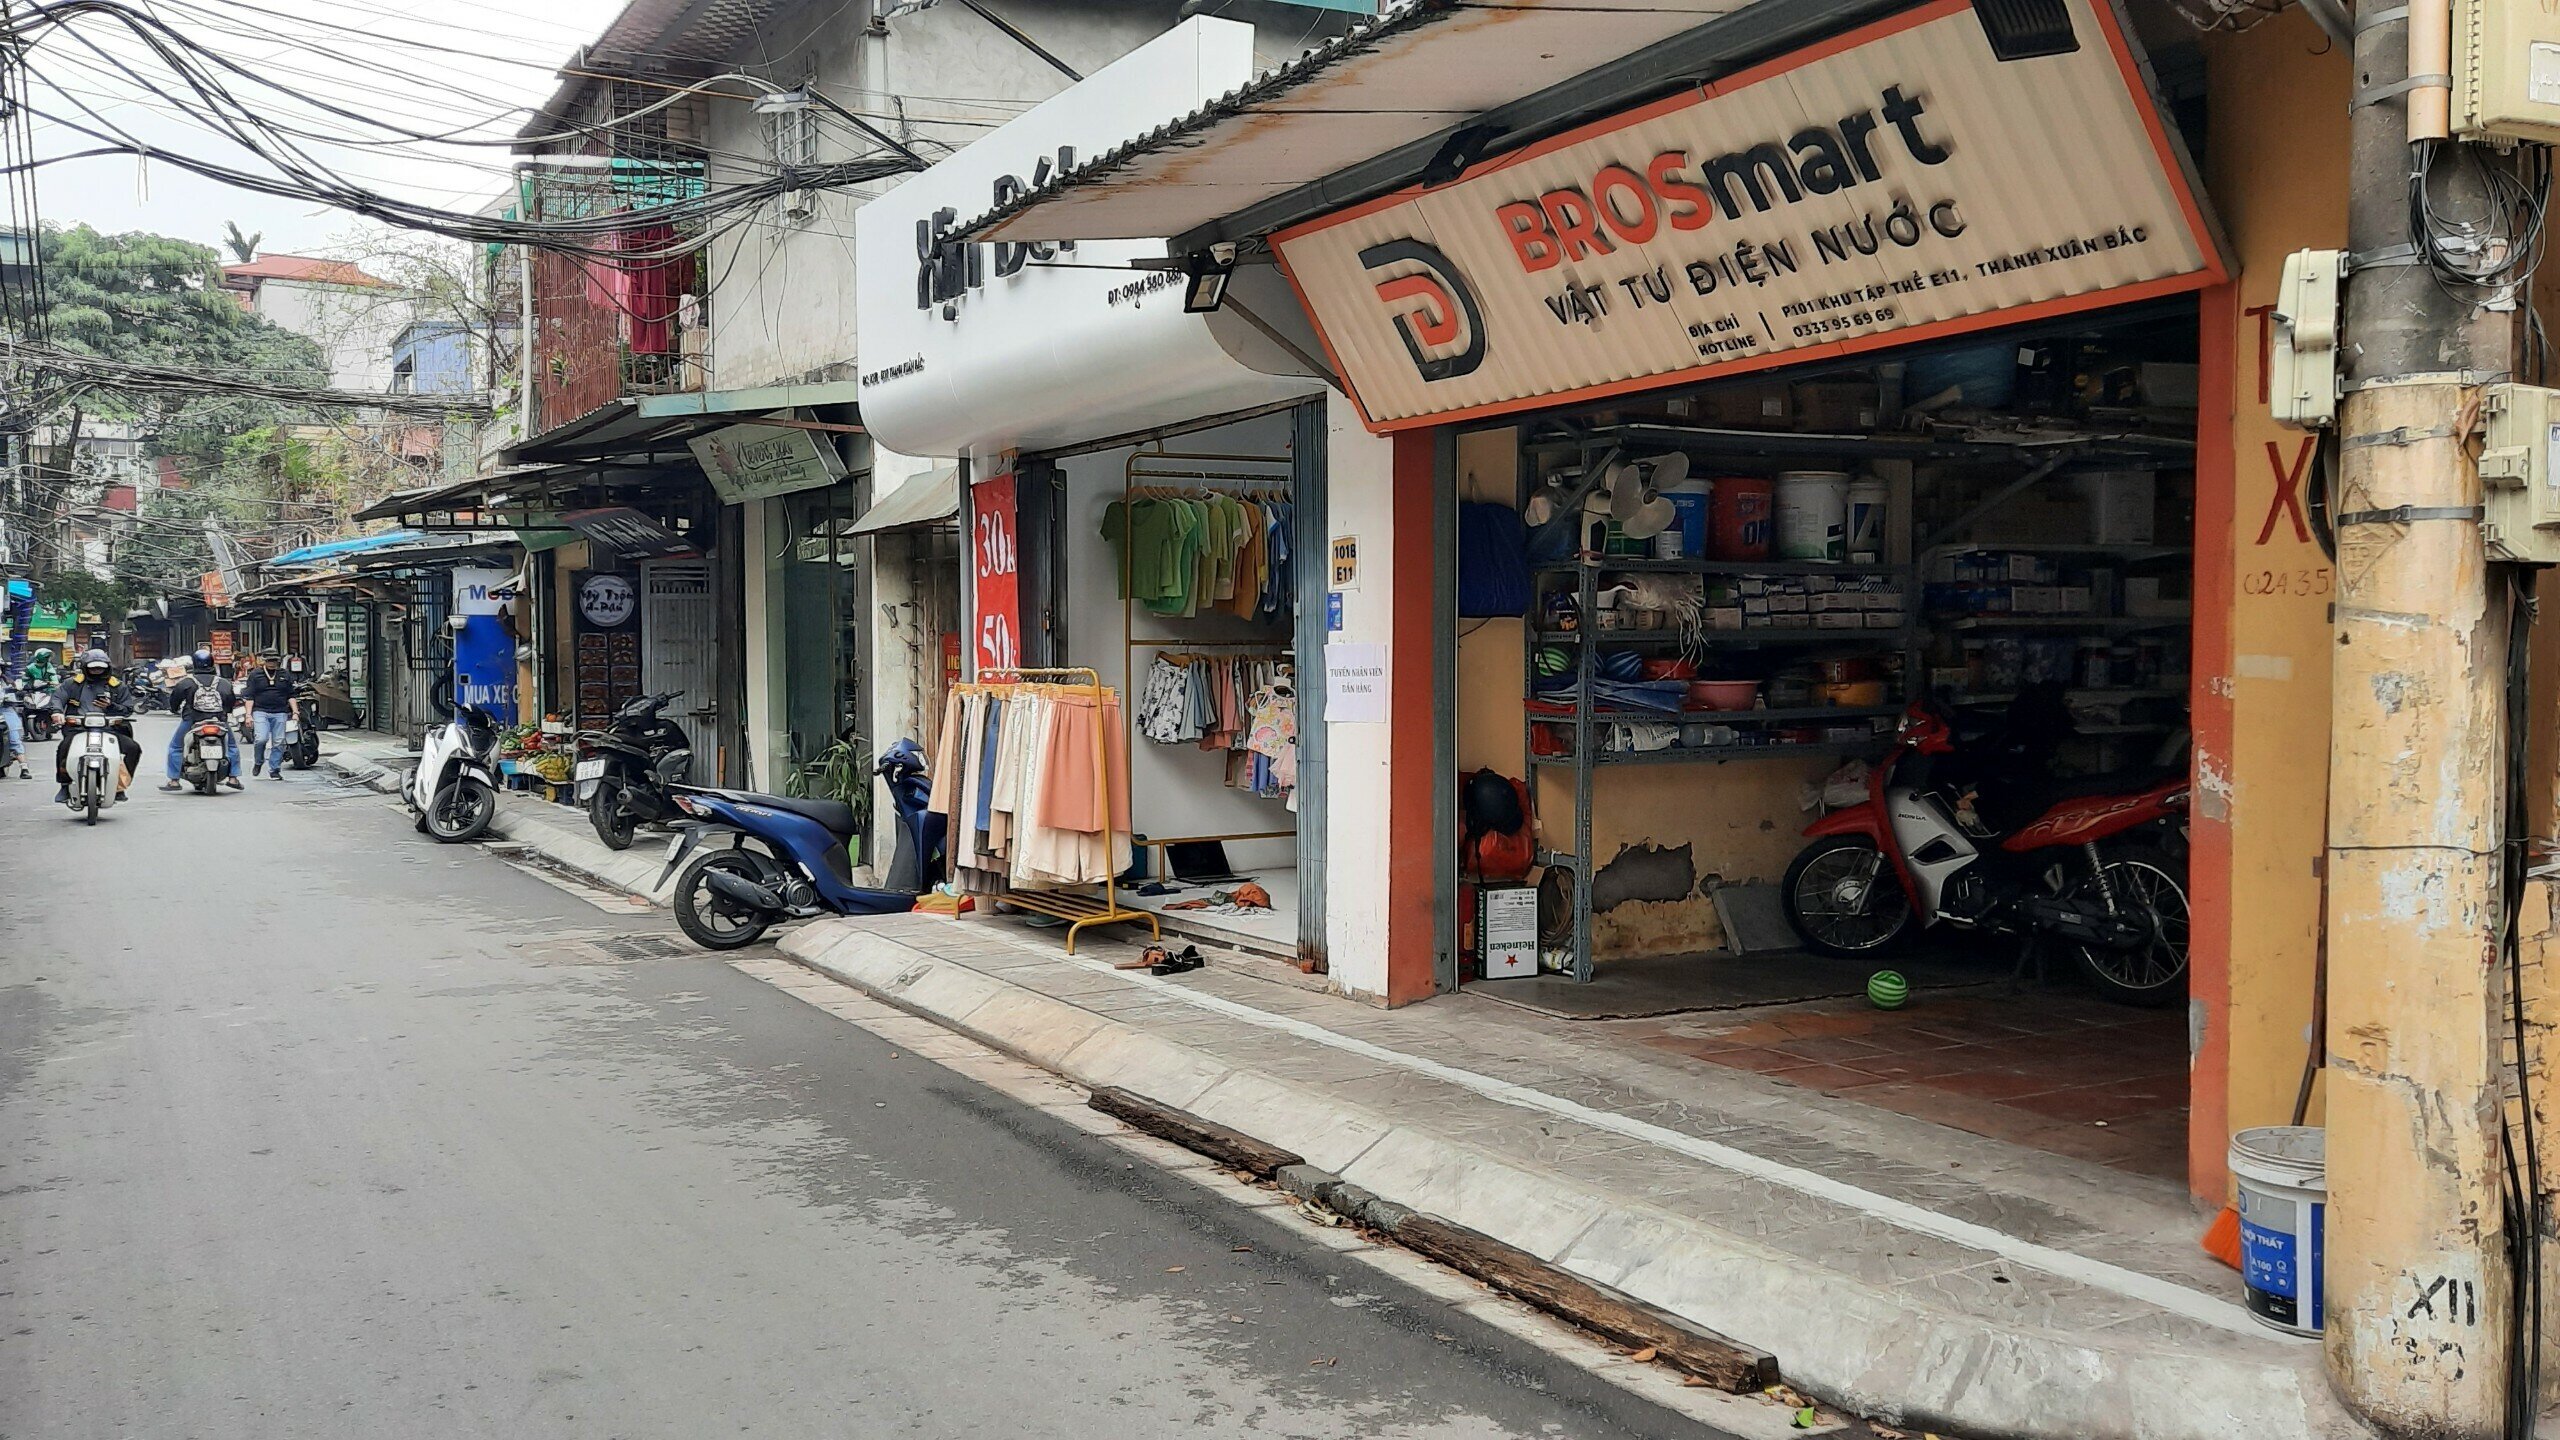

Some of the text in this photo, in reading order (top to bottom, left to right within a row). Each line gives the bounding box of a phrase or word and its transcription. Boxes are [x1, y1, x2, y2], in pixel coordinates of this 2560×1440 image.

[1496, 84, 1952, 273] BROSmart
[1545, 199, 1967, 325] VẬT TƯ ĐIỆN NƯỚC
[1781, 301, 1816, 318] P101
[1818, 294, 1852, 310] KHU
[1854, 285, 1886, 302] TẬP
[1890, 270, 1925, 294] THỂ
[1975, 251, 2041, 277] THANH
[2046, 238, 2099, 262] XUÂN
[2104, 224, 2147, 249] BẮC
[1698, 307, 1895, 356] HOTLINE 0333 95 69 69
[1337, 566, 1352, 582] E11
[328, 645, 344, 654] ANH
[464, 685, 490, 704] MUA
[1489, 941, 1534, 951] Heineken
[2257, 1235, 2284, 1250] THẤT
